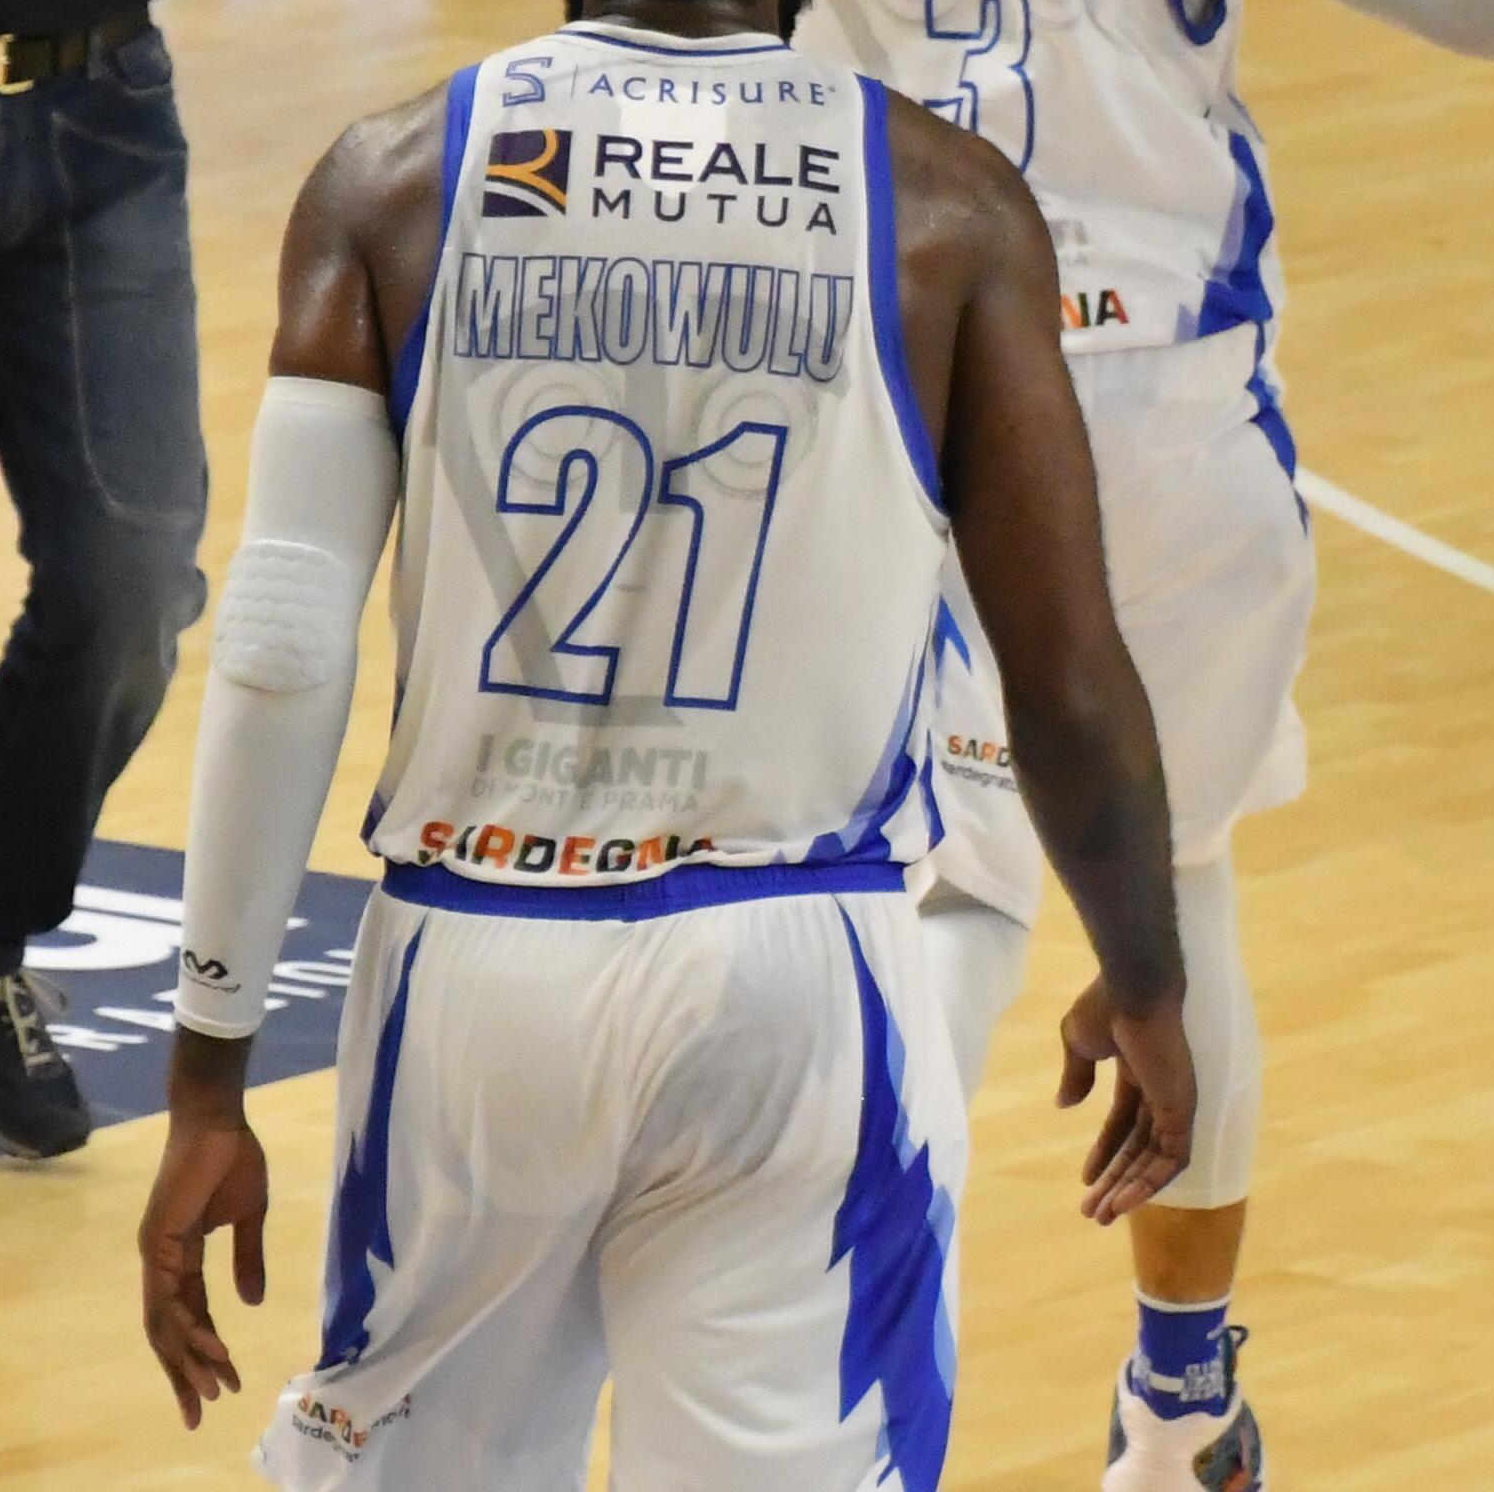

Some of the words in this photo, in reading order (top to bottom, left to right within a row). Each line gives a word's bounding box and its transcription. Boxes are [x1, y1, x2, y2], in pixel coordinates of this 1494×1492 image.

[587, 73, 839, 108] ACRISURE
[592, 133, 841, 195] REALE
[590, 187, 838, 237] MUTUA
[452, 251, 855, 384] MEKOWULU
[476, 403, 790, 712] 21
[502, 737, 710, 791] GIGANTI
